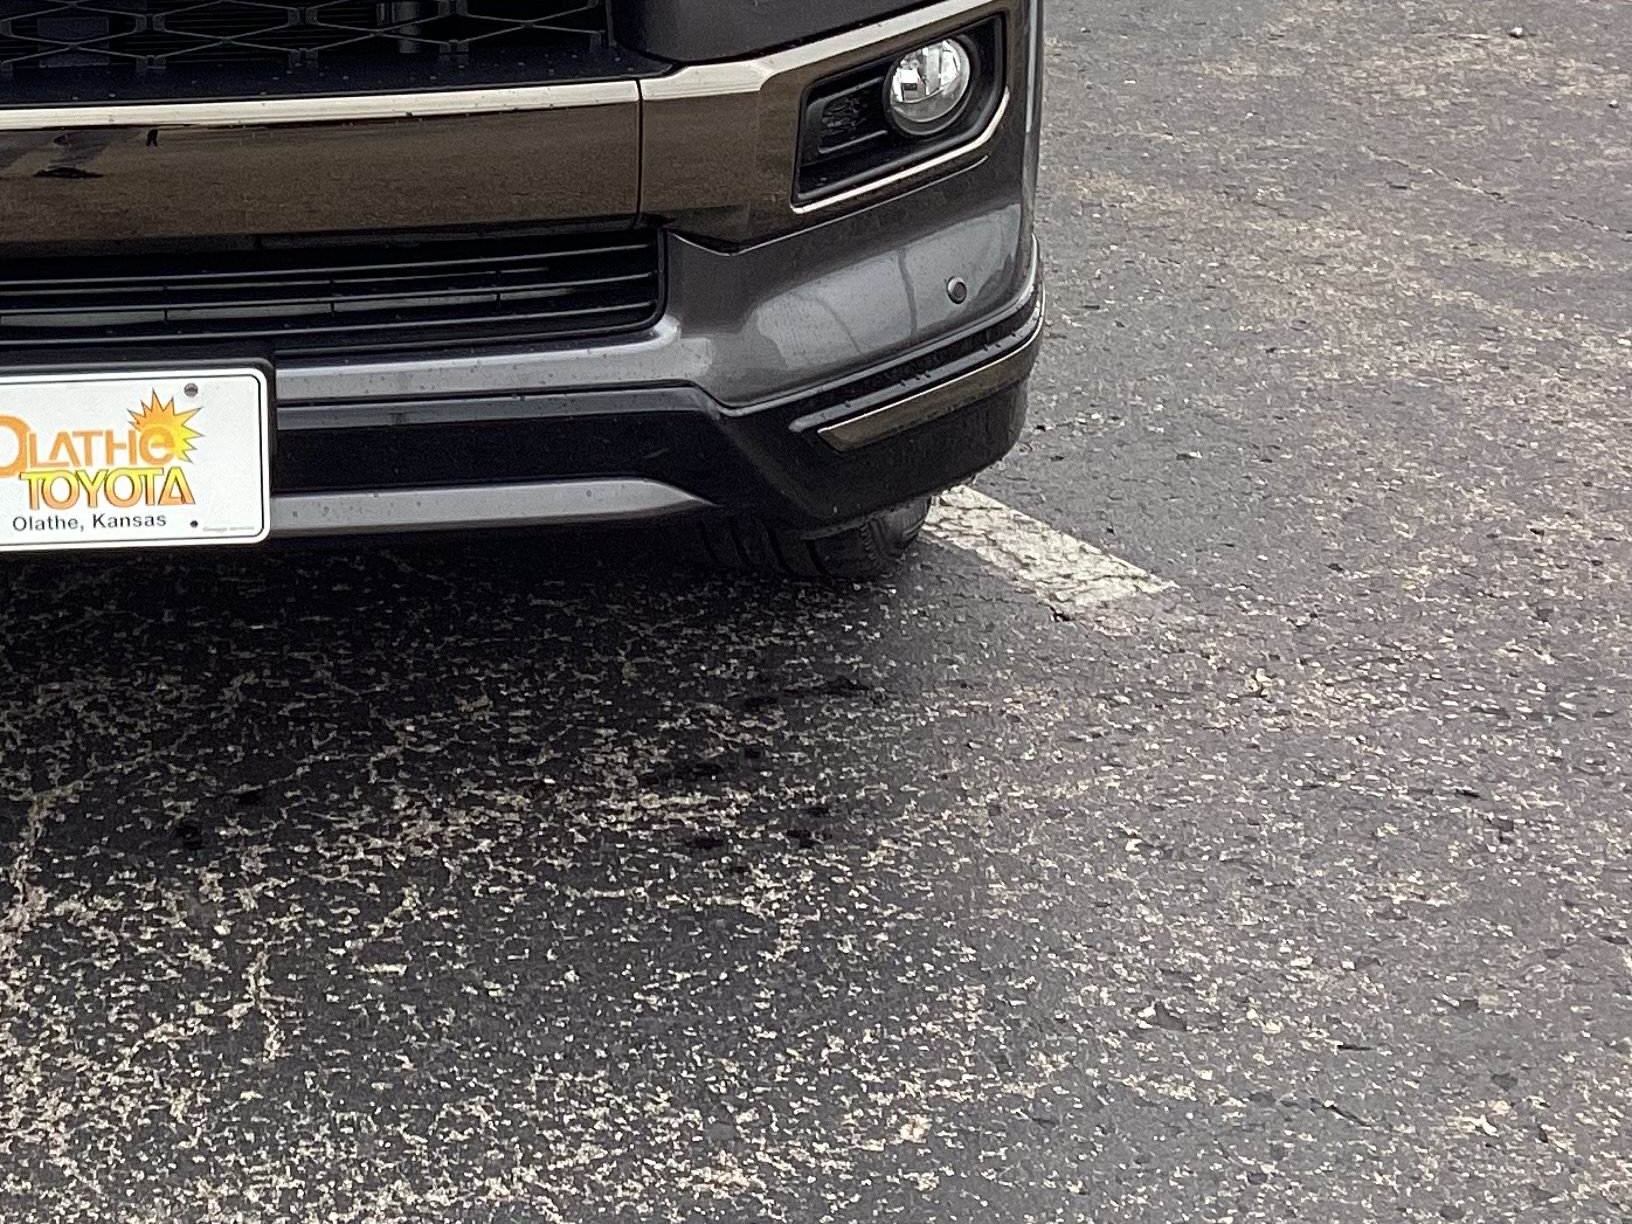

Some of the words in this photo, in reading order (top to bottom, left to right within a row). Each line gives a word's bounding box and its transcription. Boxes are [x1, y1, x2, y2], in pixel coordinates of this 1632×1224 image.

[19, 466, 196, 510] TOYOTA
[12, 514, 85, 533] Olathe,
[92, 512, 167, 529] Kansas
